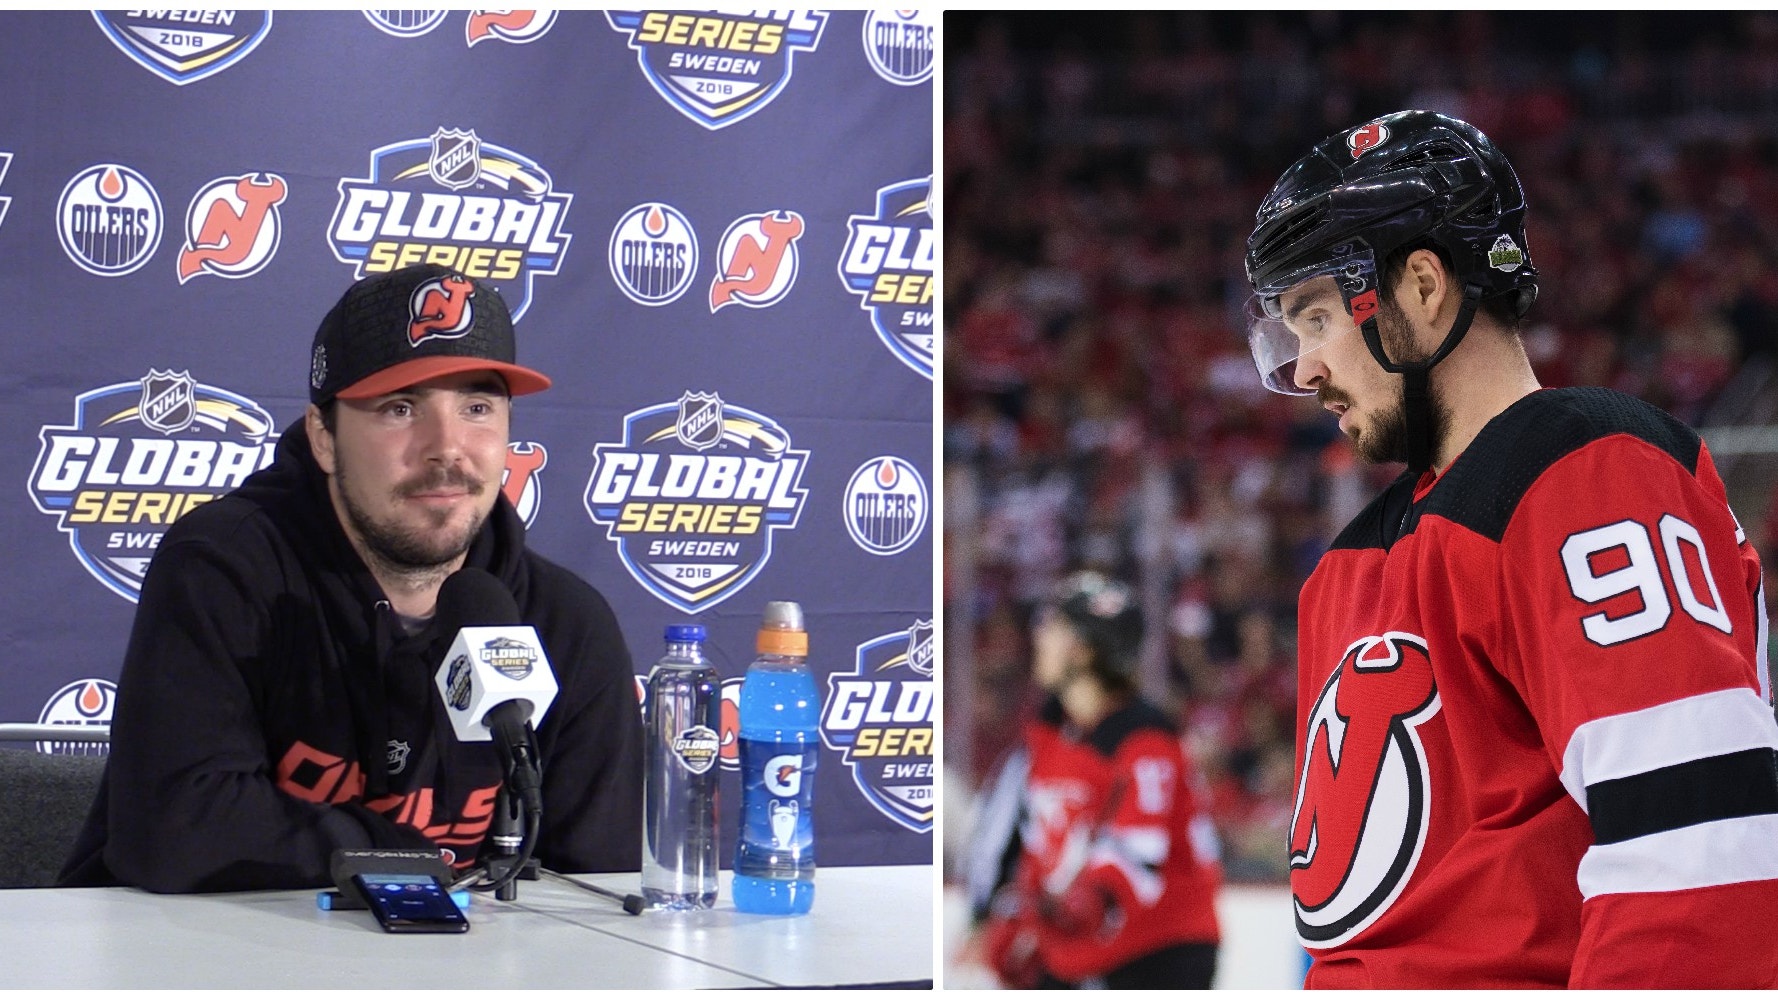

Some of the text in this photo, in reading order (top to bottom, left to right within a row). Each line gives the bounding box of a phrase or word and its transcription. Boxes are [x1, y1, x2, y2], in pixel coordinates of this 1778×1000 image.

[160, 32, 203, 47] 2018
[638, 13, 784, 54] SERIES
[669, 52, 761, 75] SWEDEN
[696, 82, 732, 95] 2018
[440, 144, 472, 175] NHL
[72, 204, 149, 241] OILERS
[336, 188, 561, 253] GLOBAL
[622, 239, 686, 274] OILERS
[152, 386, 185, 419] NHL
[687, 407, 715, 437] NHL
[592, 452, 799, 508] GLOBAL
[616, 503, 763, 534] SERIES
[856, 493, 916, 523] OILERS
[107, 532, 164, 549] SWE
[648, 541, 740, 556] SWEDEN
[675, 567, 711, 578] 2018
[1559, 512, 1733, 648] 90
[480, 648, 538, 661] GLOBAL
[826, 681, 933, 729] GLO
[764, 754, 803, 797] G
[907, 788, 933, 799] 201
